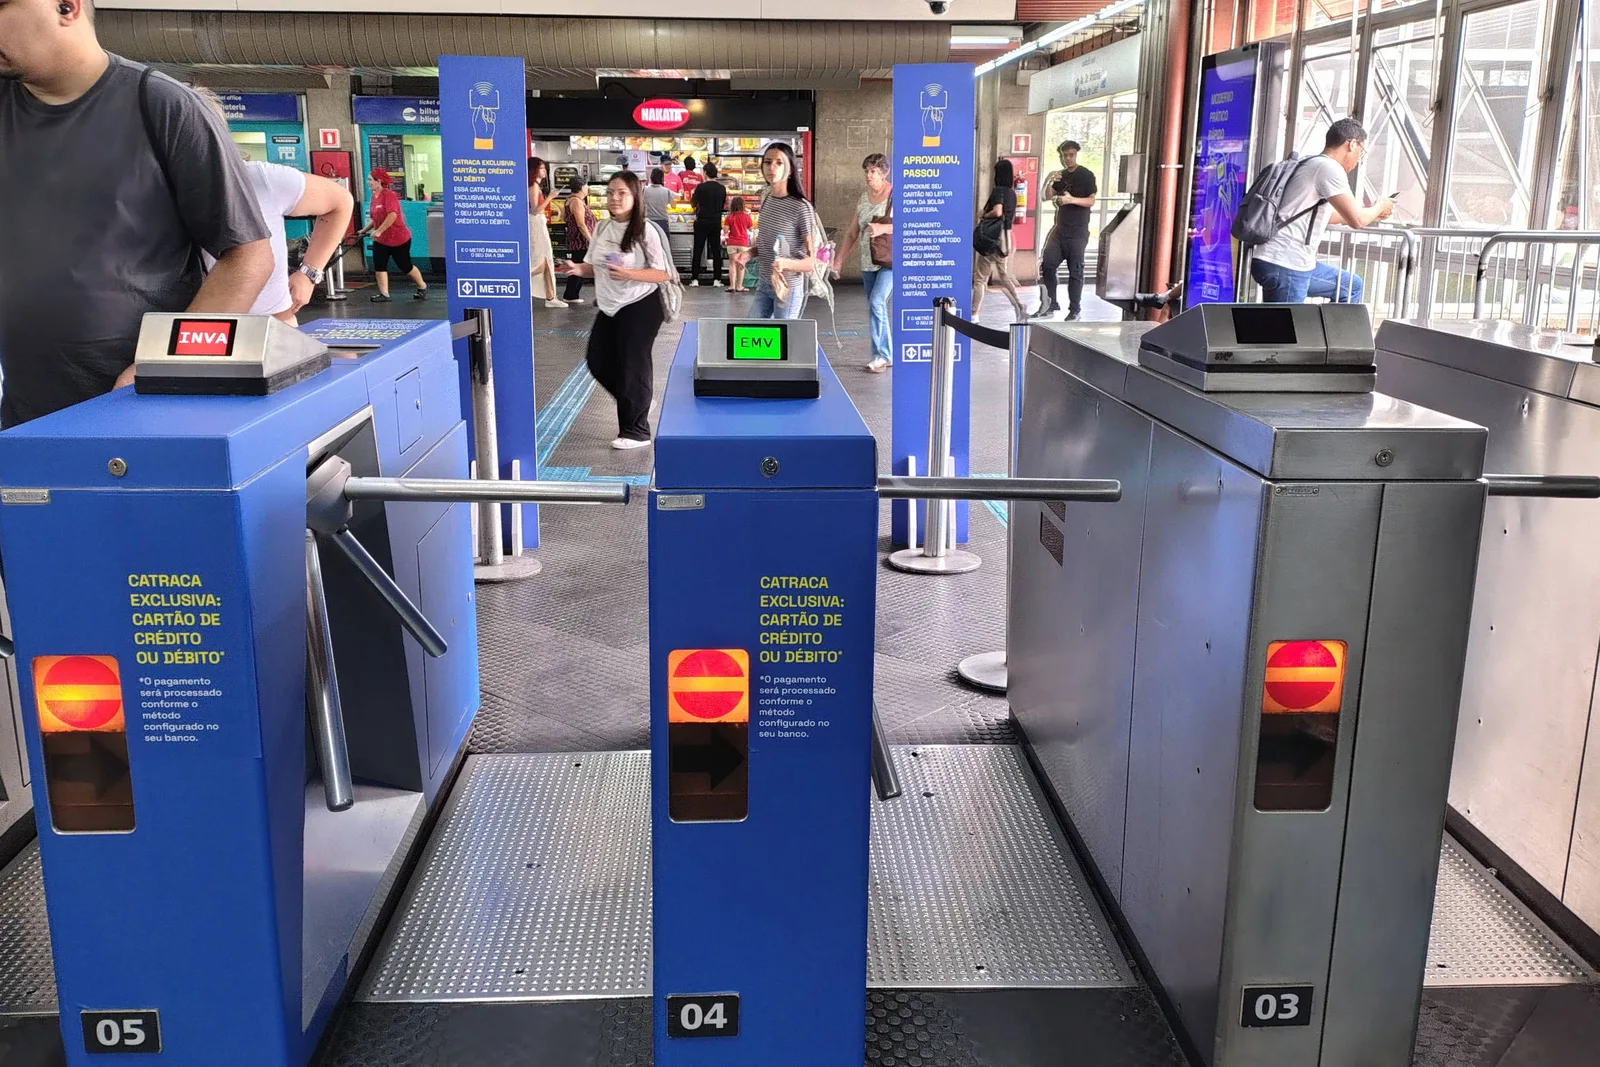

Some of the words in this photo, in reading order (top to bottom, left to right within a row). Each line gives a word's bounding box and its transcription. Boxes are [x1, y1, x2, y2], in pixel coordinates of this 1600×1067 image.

[641, 108, 688, 121] NAKATA
[903, 155, 960, 165] APROXIMOU,
[904, 169, 939, 178] PASSOU
[479, 283, 515, 294] METRÔ
[179, 332, 228, 344] INVA
[741, 337, 774, 348] EMV
[128, 574, 202, 587] CATRACA
[760, 576, 828, 588] CATRACA
[130, 594, 221, 606] EXCLUSIVA:
[760, 596, 844, 607] EXCLUSIVA:
[132, 610, 195, 626] CARTÃO
[200, 614, 220, 626] DE
[760, 612, 818, 626] CARTÃO
[823, 614, 842, 626] DE
[134, 630, 201, 645] CRÉDITO
[760, 630, 822, 644] CRÉDITO
[136, 651, 159, 664] OU
[760, 651, 780, 662] OU
[154, 678, 211, 687] pagamento
[774, 676, 826, 685] pagamento
[164, 689, 222, 698] processado
[782, 687, 836, 695] processado
[144, 723, 204, 732] configurado
[759, 719, 815, 728] configurado
[1255, 993, 1299, 1020] 03
[681, 1003, 727, 1030] 04
[96, 1019, 145, 1046] 05
